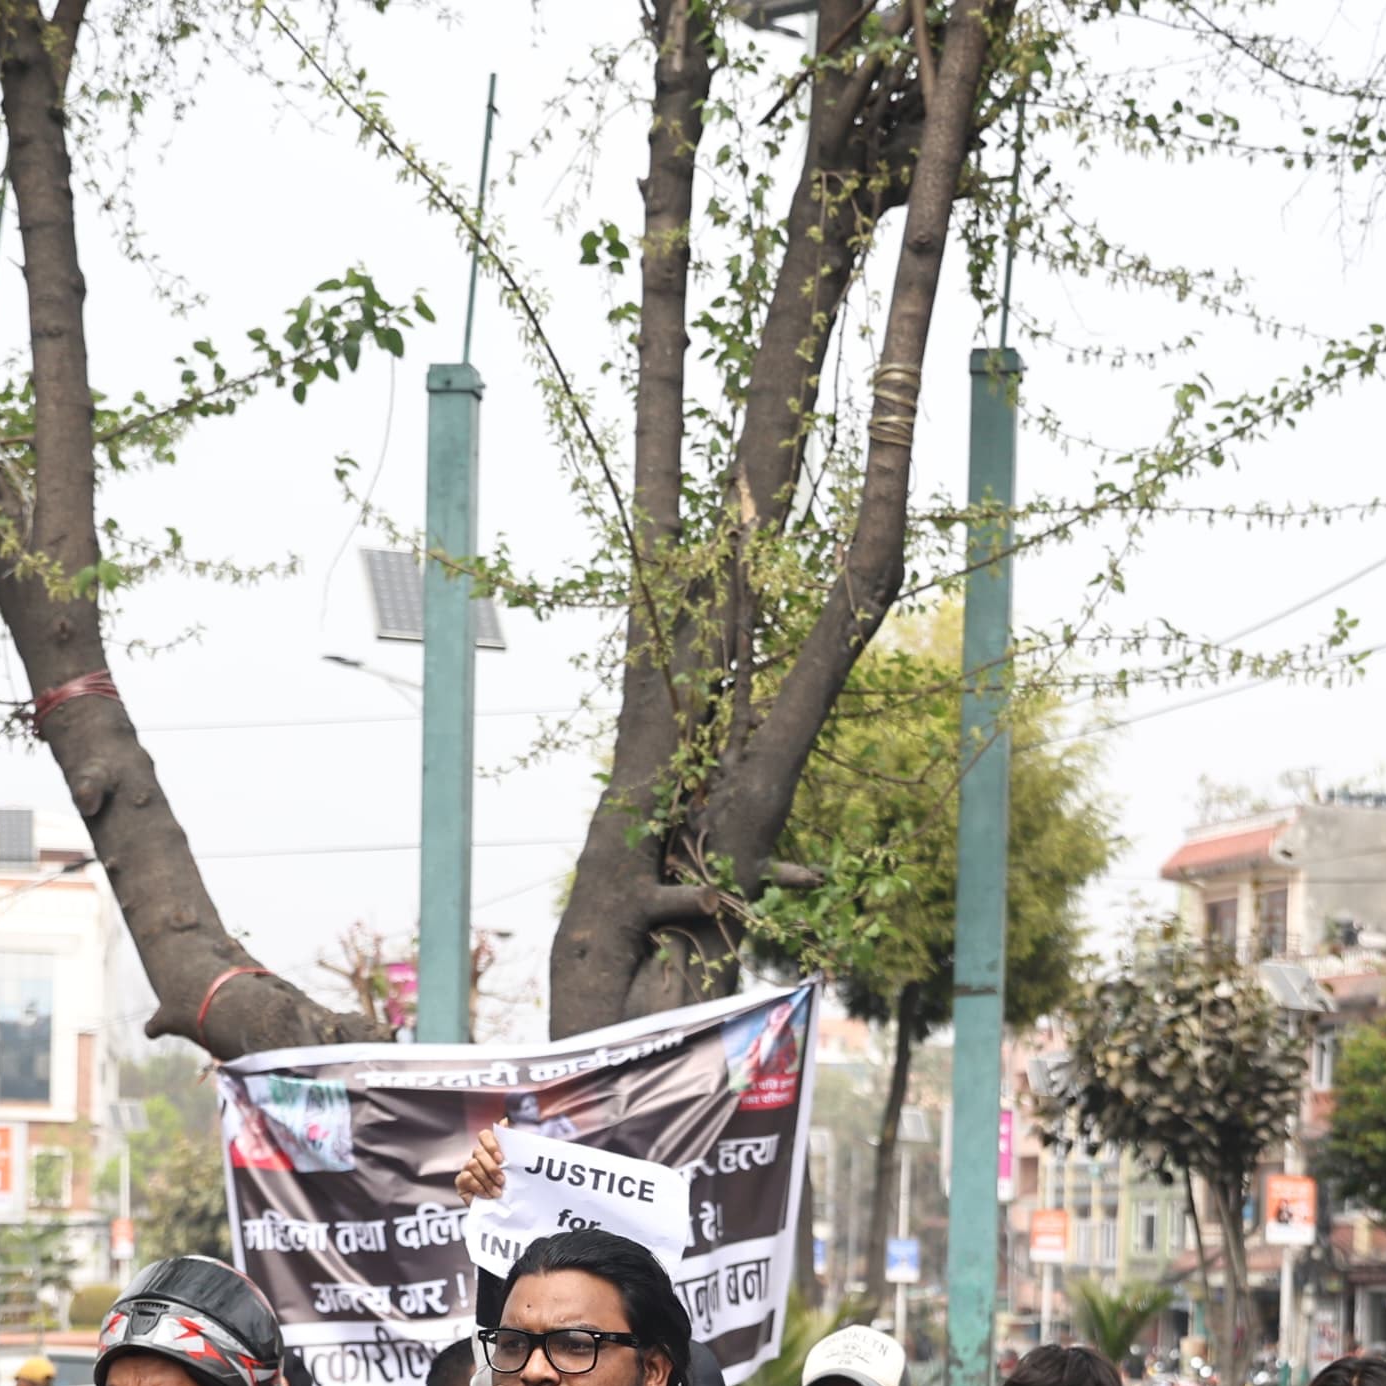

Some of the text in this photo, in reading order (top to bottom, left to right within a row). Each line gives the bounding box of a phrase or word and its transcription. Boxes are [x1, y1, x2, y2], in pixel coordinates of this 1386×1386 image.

[525, 1155, 655, 1203] JUSTICE
[335, 1219, 387, 1254] तथा
[557, 1209, 602, 1232] for
[399, 1279, 449, 1315] गर
